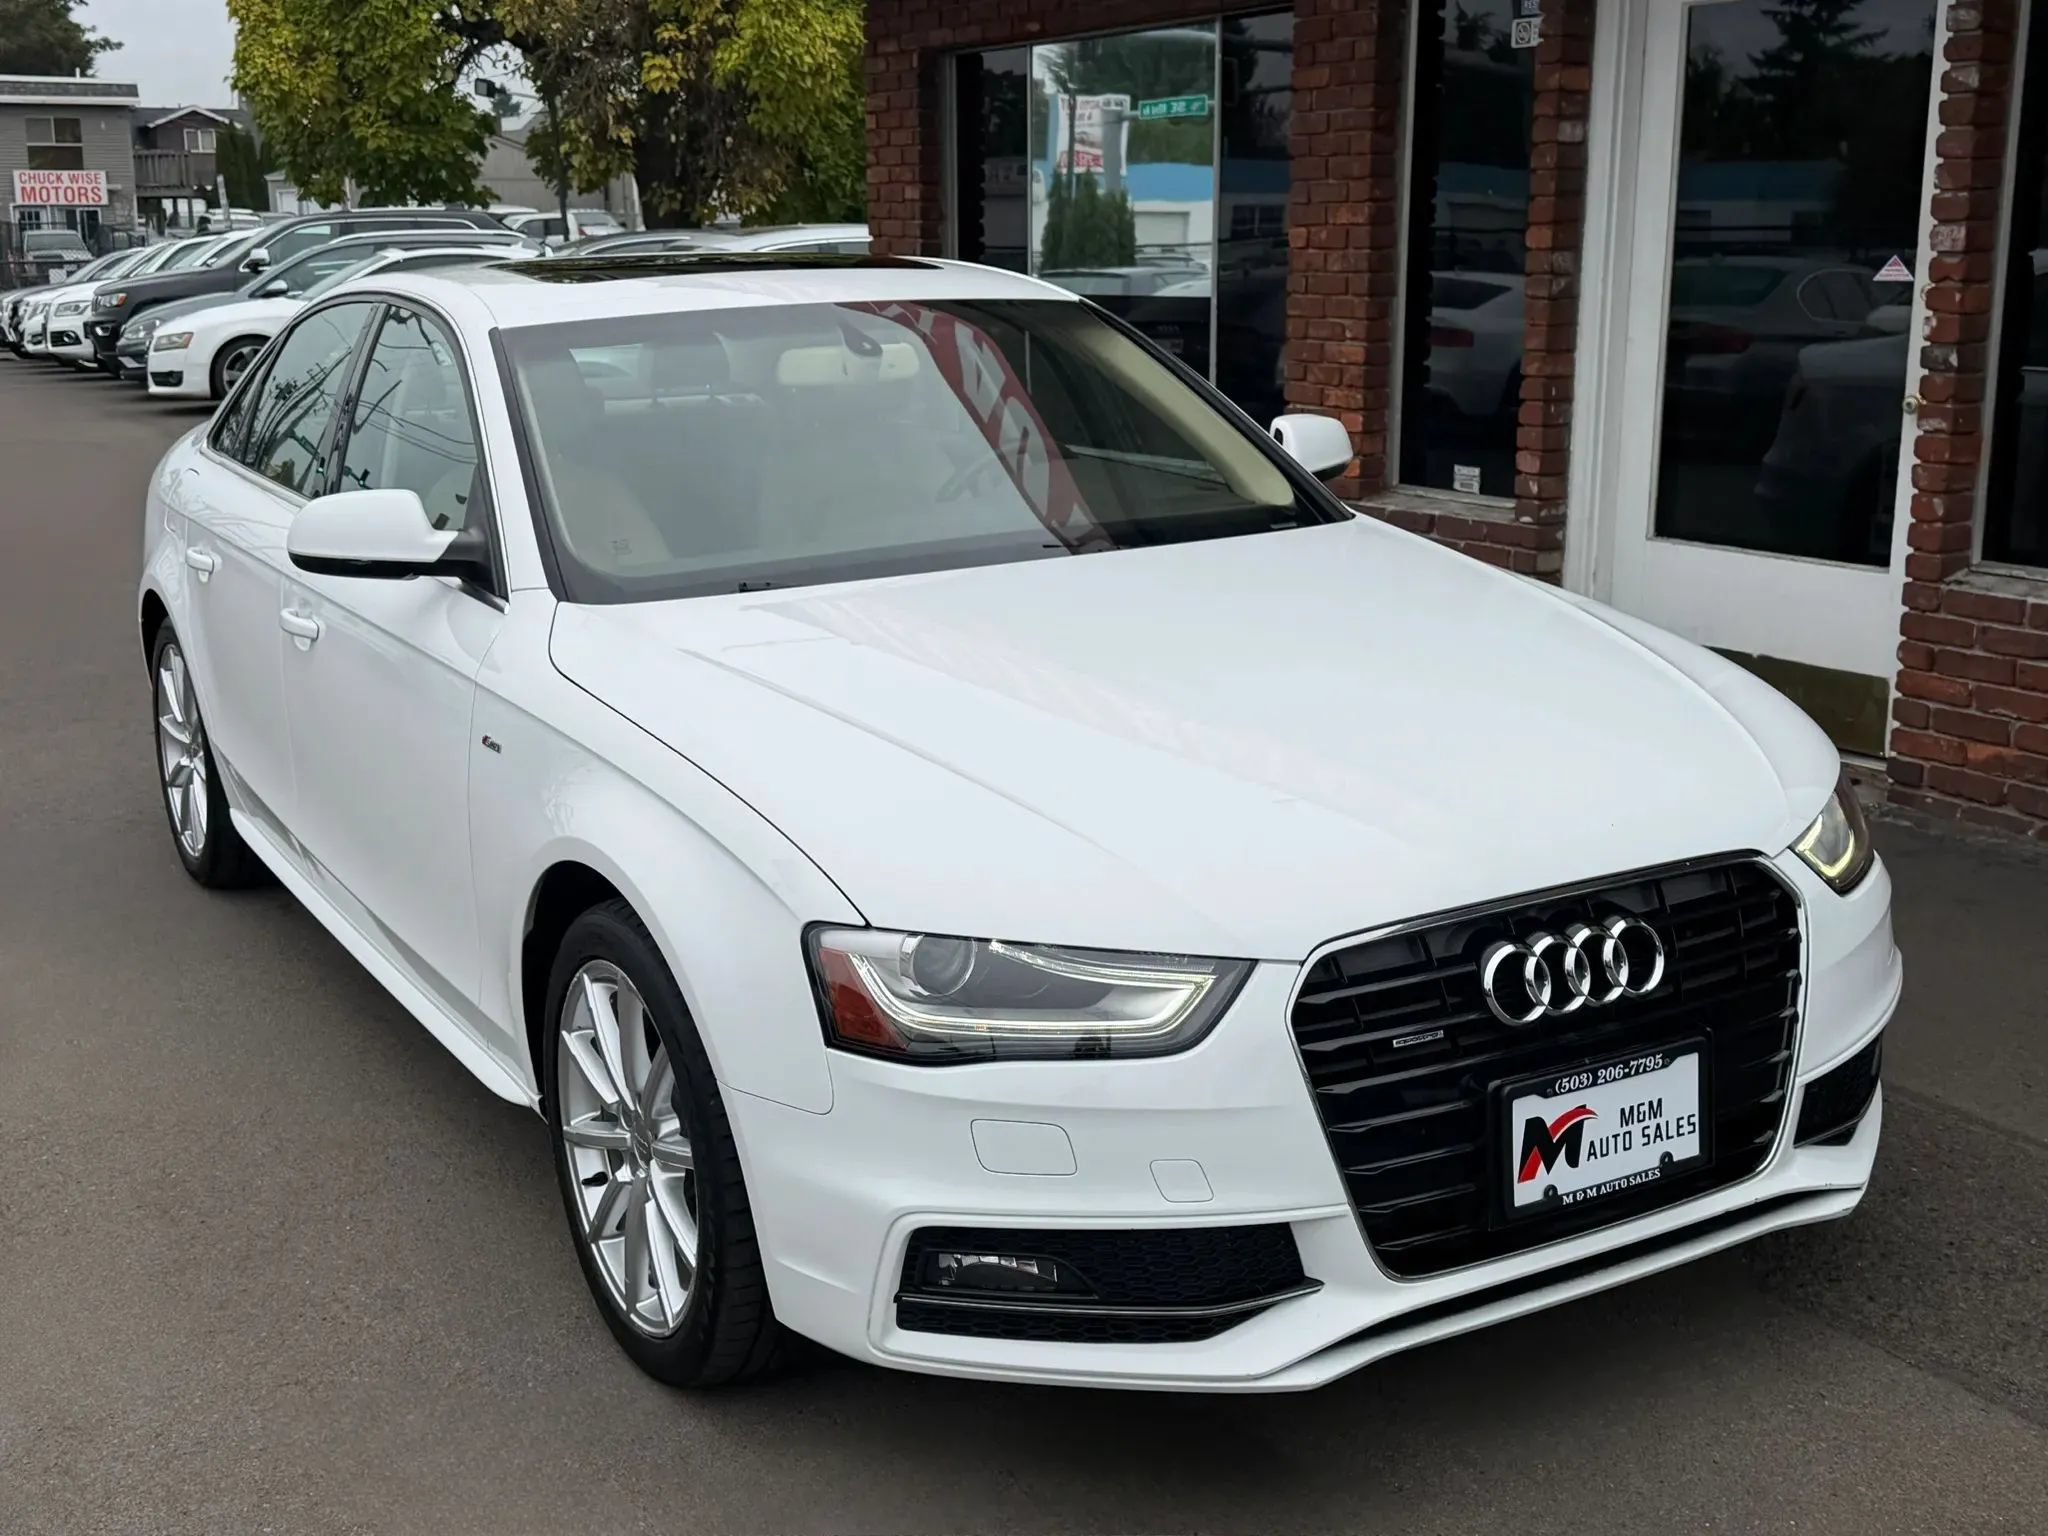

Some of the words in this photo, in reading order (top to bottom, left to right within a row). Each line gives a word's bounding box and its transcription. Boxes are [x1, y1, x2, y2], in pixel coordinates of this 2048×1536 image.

[19, 172, 64, 185] CHUCK
[67, 172, 102, 185] WISE
[20, 186, 102, 203] MOTORS
[1555, 1073, 1593, 1094] (503)
[1597, 1053, 1663, 1084] 206-7795
[1619, 1097, 1663, 1129] M&M
[1586, 1130, 1633, 1162] AUTO
[1641, 1113, 1697, 1147] SALES
[1562, 1194, 1574, 1205] M
[1576, 1191, 1585, 1202] &
[1586, 1187, 1598, 1199] M
[1599, 1178, 1628, 1195] AUTO
[1628, 1168, 1662, 1186] SALES
